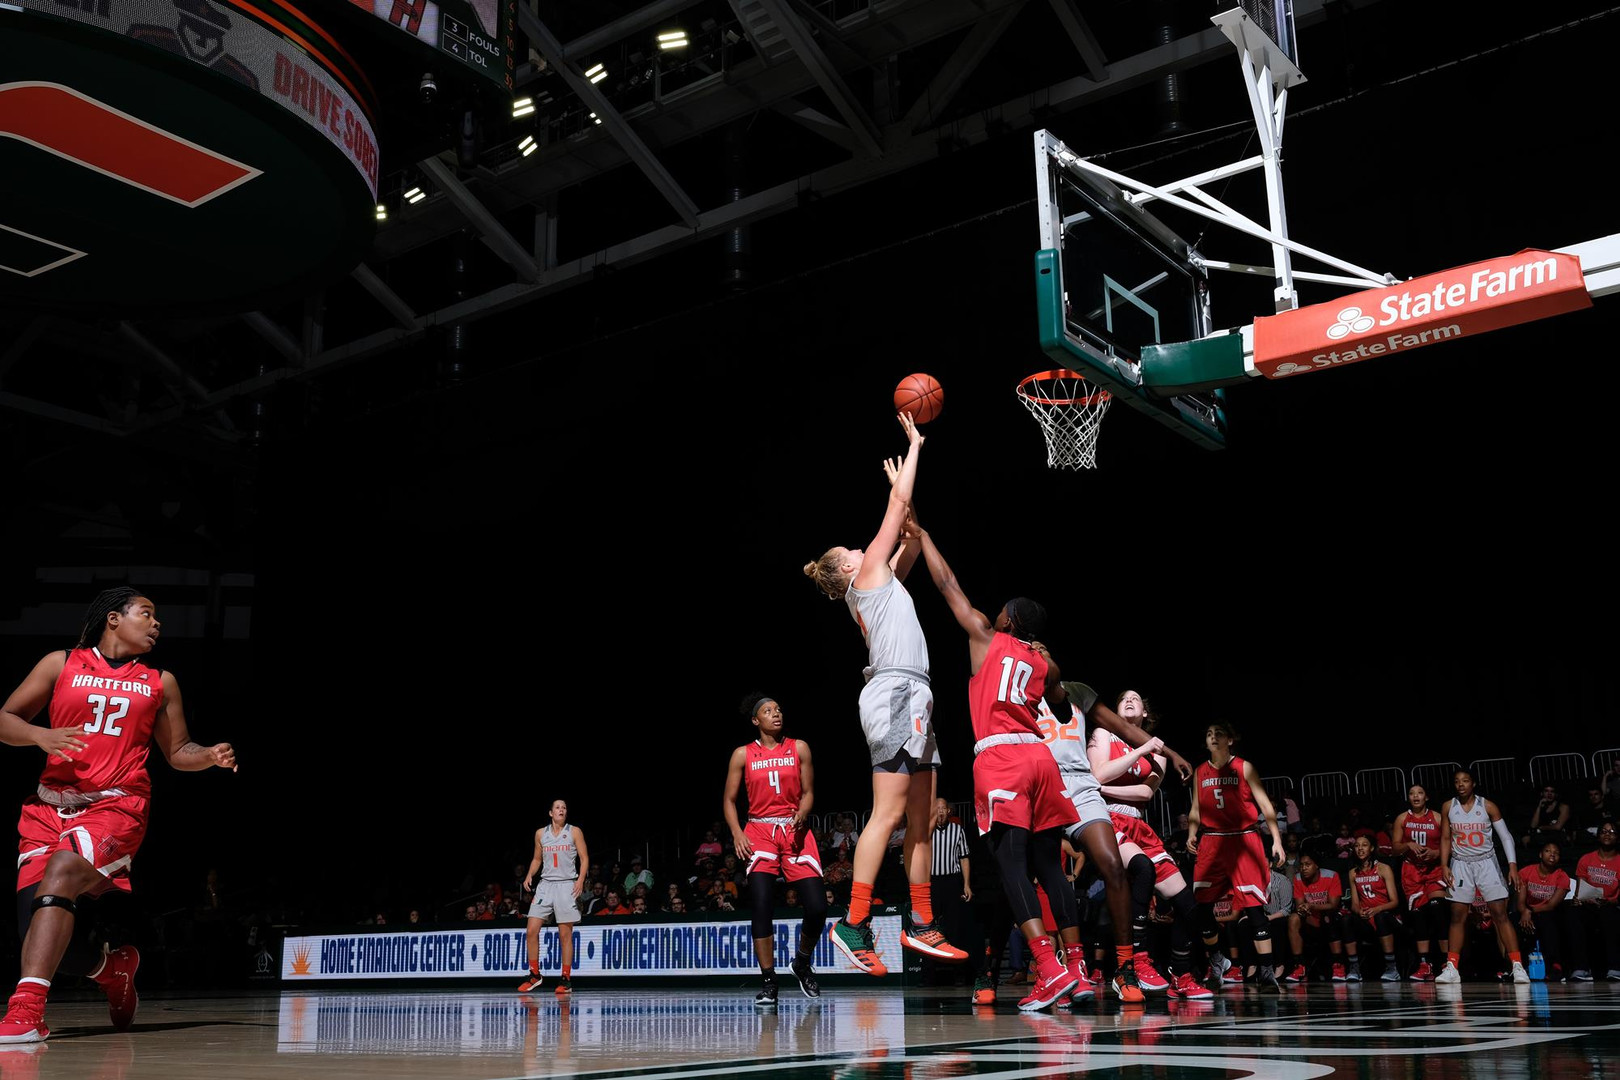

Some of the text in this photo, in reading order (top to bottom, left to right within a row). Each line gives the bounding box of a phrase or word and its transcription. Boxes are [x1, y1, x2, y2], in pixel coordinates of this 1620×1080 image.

[452, 22, 500, 56] 3 FOULS
[452, 43, 487, 68] 4 TOL
[273, 51, 344, 138] DRIVE
[71, 674, 152, 698] HARTFORD
[997, 655, 1034, 706] 10
[83, 693, 131, 737] 32
[1036, 716, 1081, 744] 32
[751, 756, 795, 771] HARTFORD
[768, 770, 781, 794] 4
[1201, 776, 1239, 788] HARTFORD
[1213, 788, 1225, 810] 5
[1411, 830, 1427, 847] 40
[553, 853, 558, 868] 1
[320, 938, 355, 974] HOME
[356, 936, 419, 973] FINANCING
[420, 934, 465, 972] CENTER
[483, 931, 581, 971] 800.70.300
